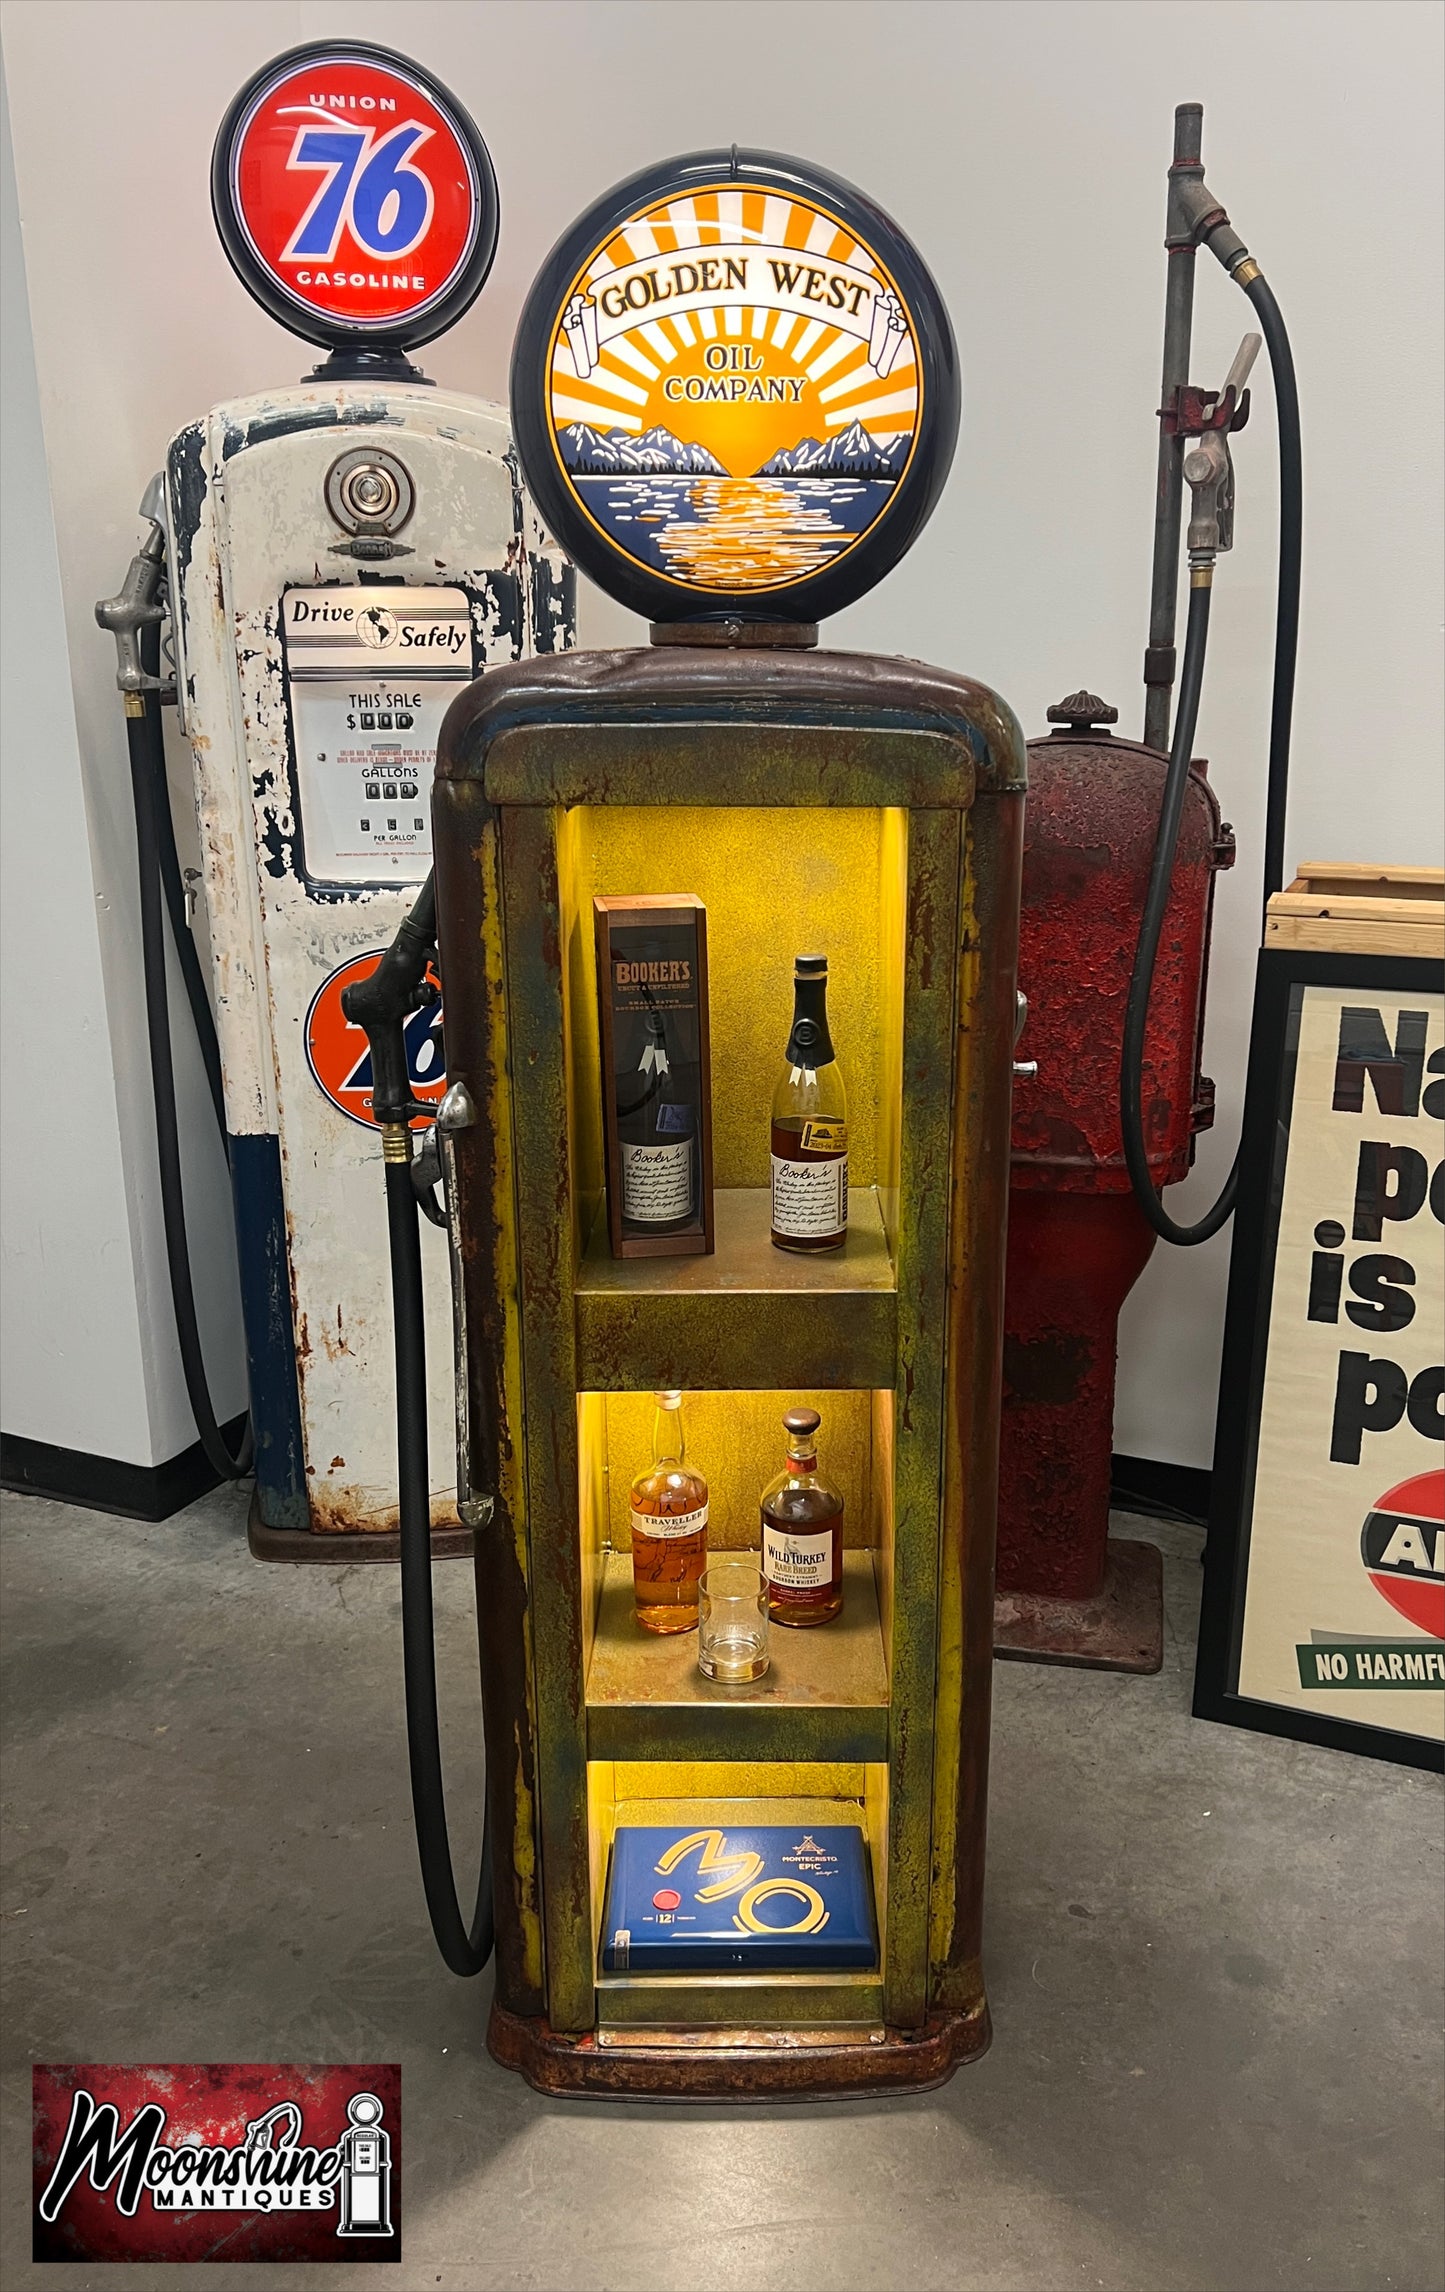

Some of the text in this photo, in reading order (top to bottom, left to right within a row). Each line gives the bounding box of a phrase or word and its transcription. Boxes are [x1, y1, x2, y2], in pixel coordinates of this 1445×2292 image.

[309, 94, 396, 111] UNION
[278, 118, 437, 262] 76
[296, 271, 425, 290] GASOLINE
[601, 258, 871, 318] GOLDEN WEST
[706, 346, 762, 370] OIL
[665, 377, 806, 402] COMPANY
[292, 601, 466, 653] Drive Safely
[349, 693, 421, 708] THIS SALE
[361, 768, 418, 778] GALLONS
[616, 961, 690, 984] BOOKER'S
[631, 1147, 684, 1163] Booker's
[779, 1163, 832, 1179] Booker's
[1307, 1219, 1416, 1332] is
[644, 1510, 702, 1525] TRAVELLER
[768, 1544, 826, 1565] WILD TURKEY
[1379, 1523, 1445, 1571] A
[793, 1565, 817, 1574] BREED
[1315, 1653, 1348, 1680] NO
[659, 1913, 672, 1923] 12
